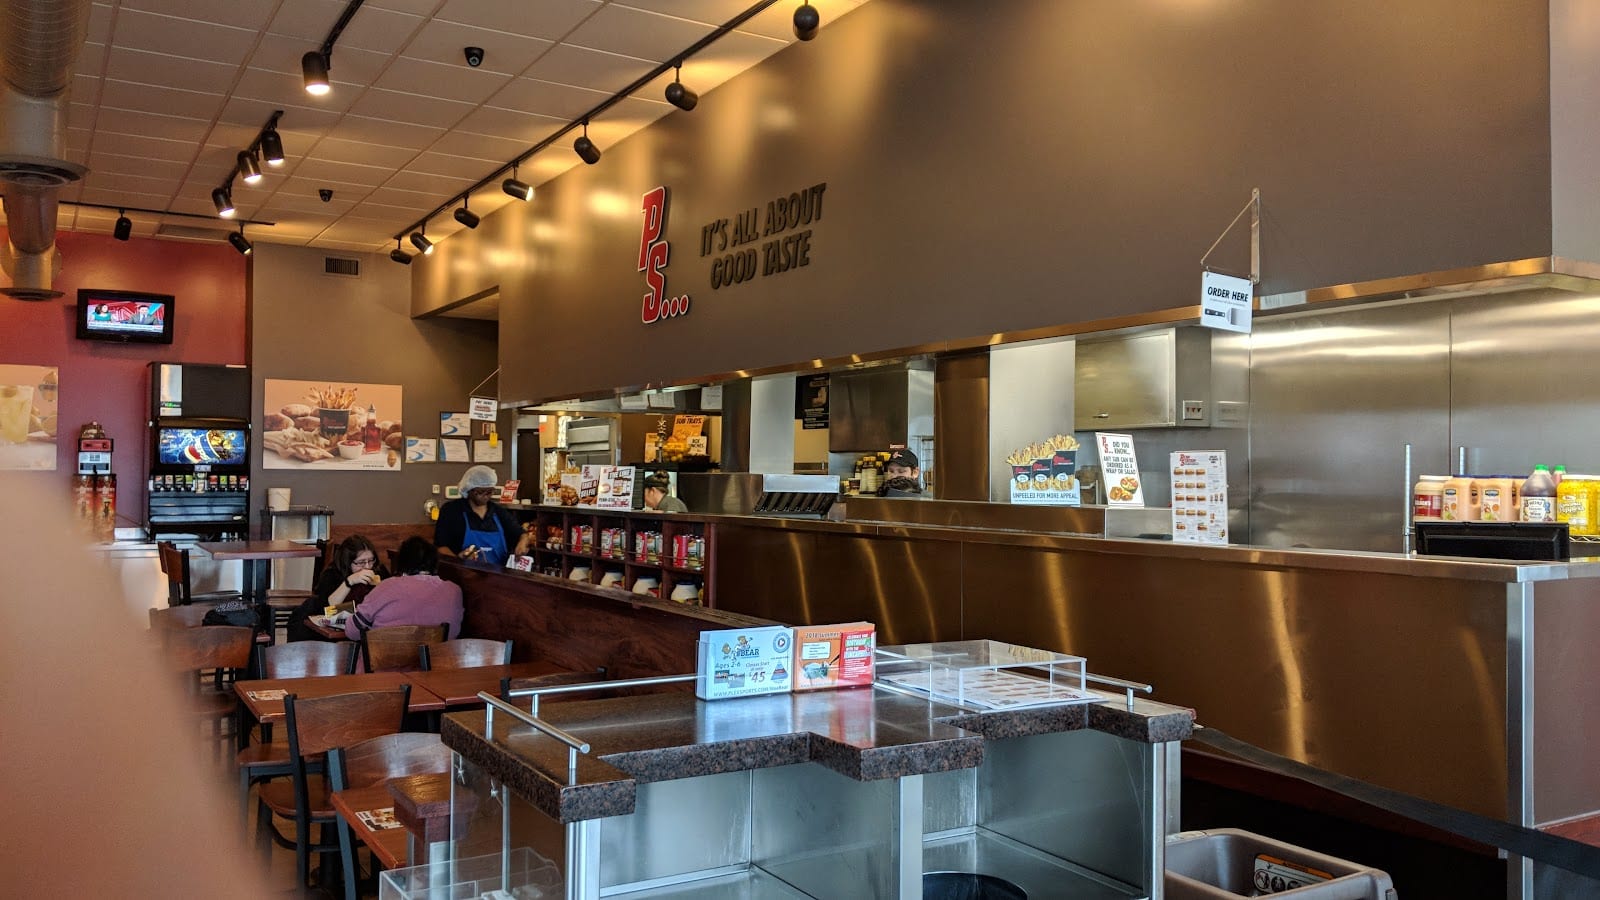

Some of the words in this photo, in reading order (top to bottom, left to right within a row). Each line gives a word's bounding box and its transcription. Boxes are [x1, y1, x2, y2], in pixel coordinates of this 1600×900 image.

[701, 218, 728, 257] IT'S
[731, 207, 759, 247] ALL
[763, 182, 827, 237] ABOUT
[710, 248, 757, 290] GOOD
[762, 229, 812, 277] TASTE
[1207, 286, 1230, 299] ORDER
[1231, 290, 1249, 303] HERE
[740, 648, 760, 657] BEAR
